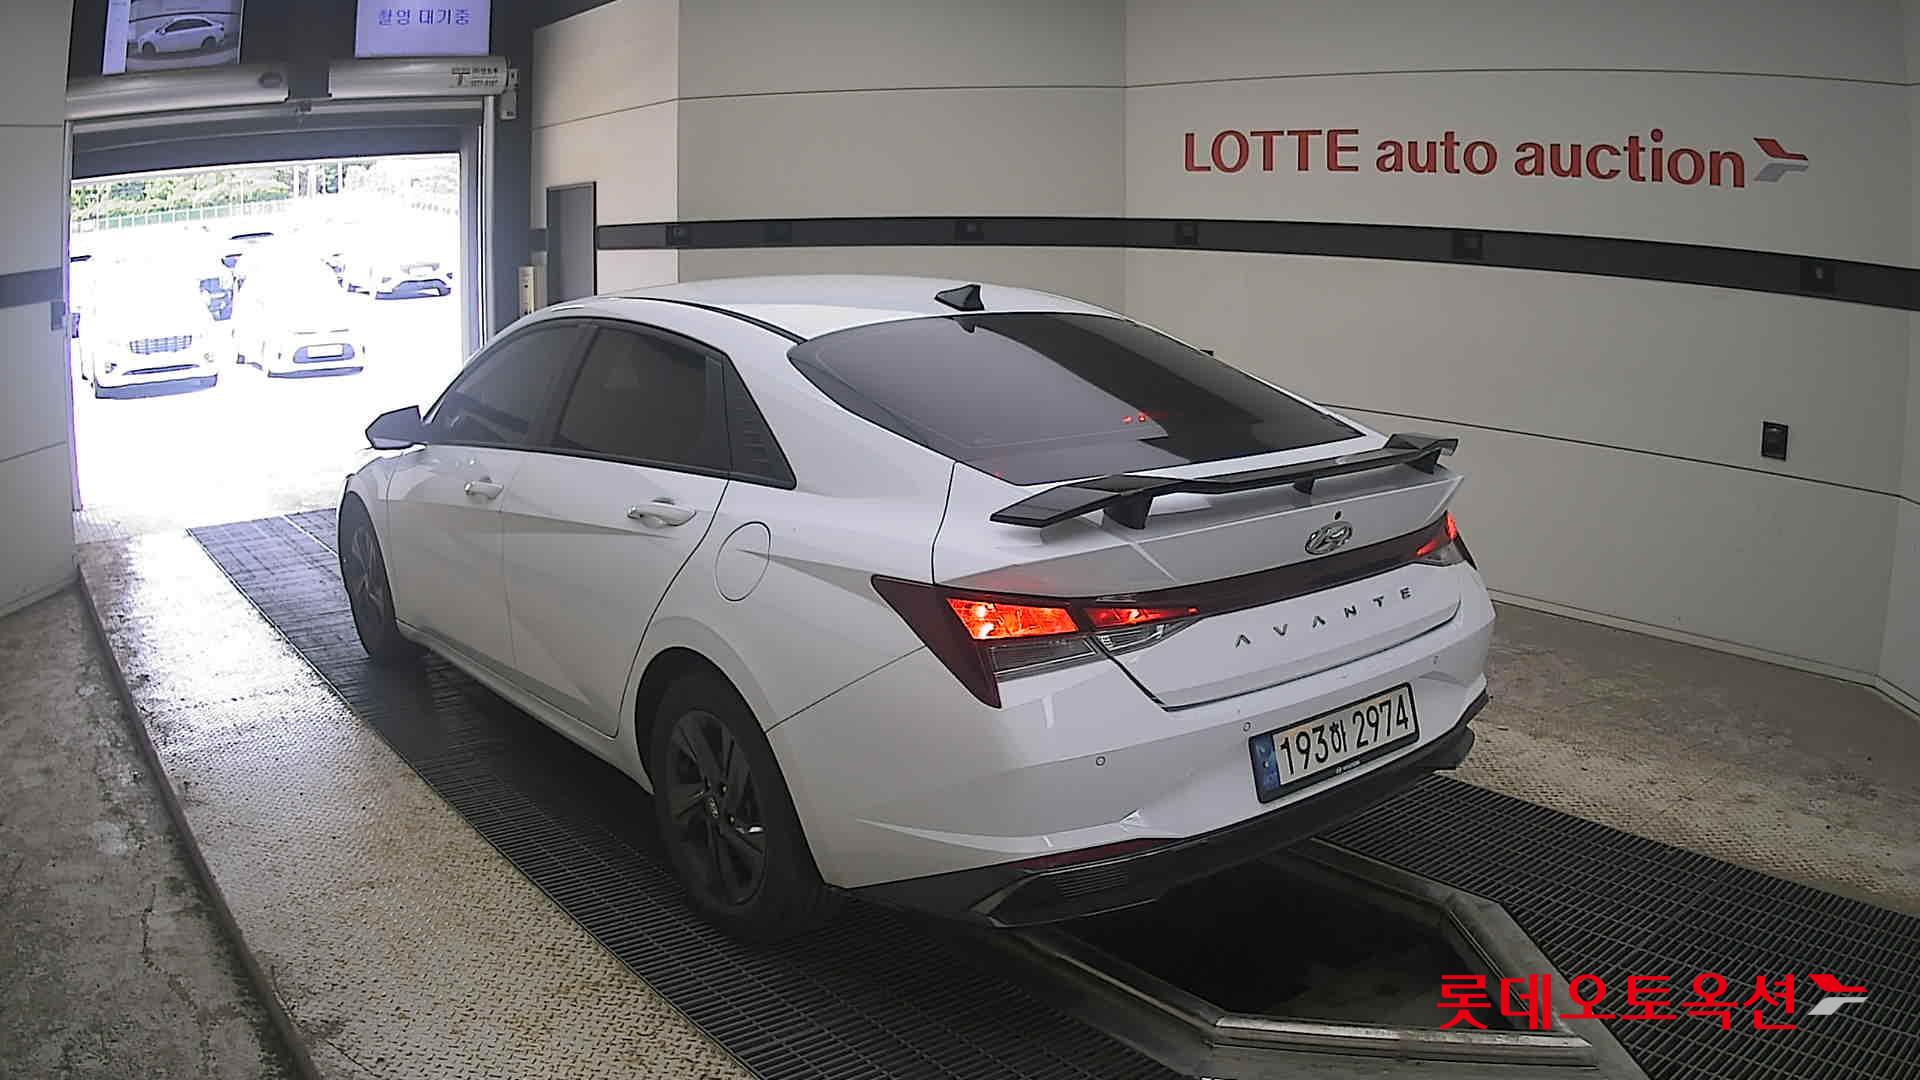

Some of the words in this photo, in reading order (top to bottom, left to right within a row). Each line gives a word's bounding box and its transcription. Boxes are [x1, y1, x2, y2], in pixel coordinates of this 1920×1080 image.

[418, 8, 472, 26] 대기중
[1184, 128, 1360, 173] LOTTE
[1375, 130, 1498, 175] auto
[1513, 128, 1746, 188] auction
[1234, 587, 1413, 648] AVANTE
[1279, 719, 1348, 776] 193하
[1352, 694, 1409, 749] 2974
